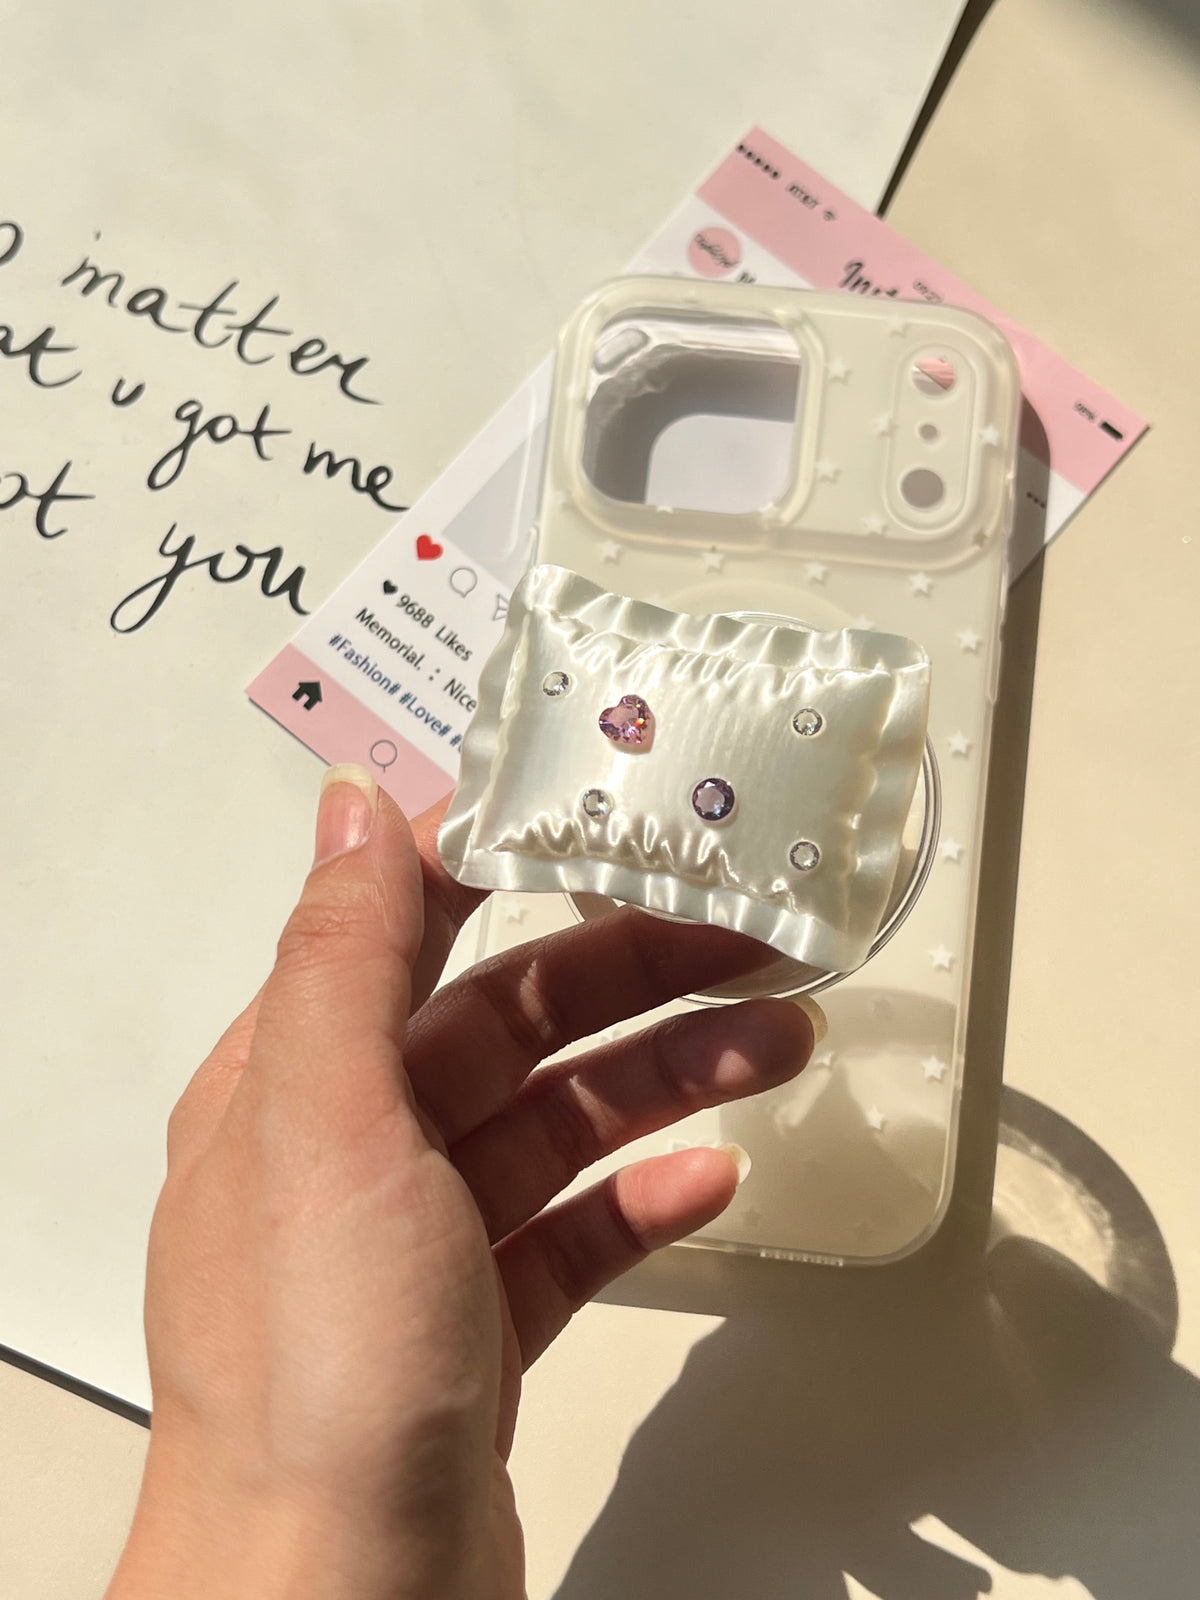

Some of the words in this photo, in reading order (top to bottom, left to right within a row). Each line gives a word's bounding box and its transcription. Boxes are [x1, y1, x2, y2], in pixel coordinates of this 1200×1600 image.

[61, 256, 383, 404] matter
[112, 378, 145, 406] u
[148, 400, 292, 490] got
[303, 442, 410, 512] me
[110, 522, 310, 633] you
[397, 594, 435, 629] 9688
[435, 624, 473, 662] Likes
[328, 633, 402, 696] #Fashion#
[399, 692, 452, 737] #Love#
[443, 678, 477, 713] Nice
